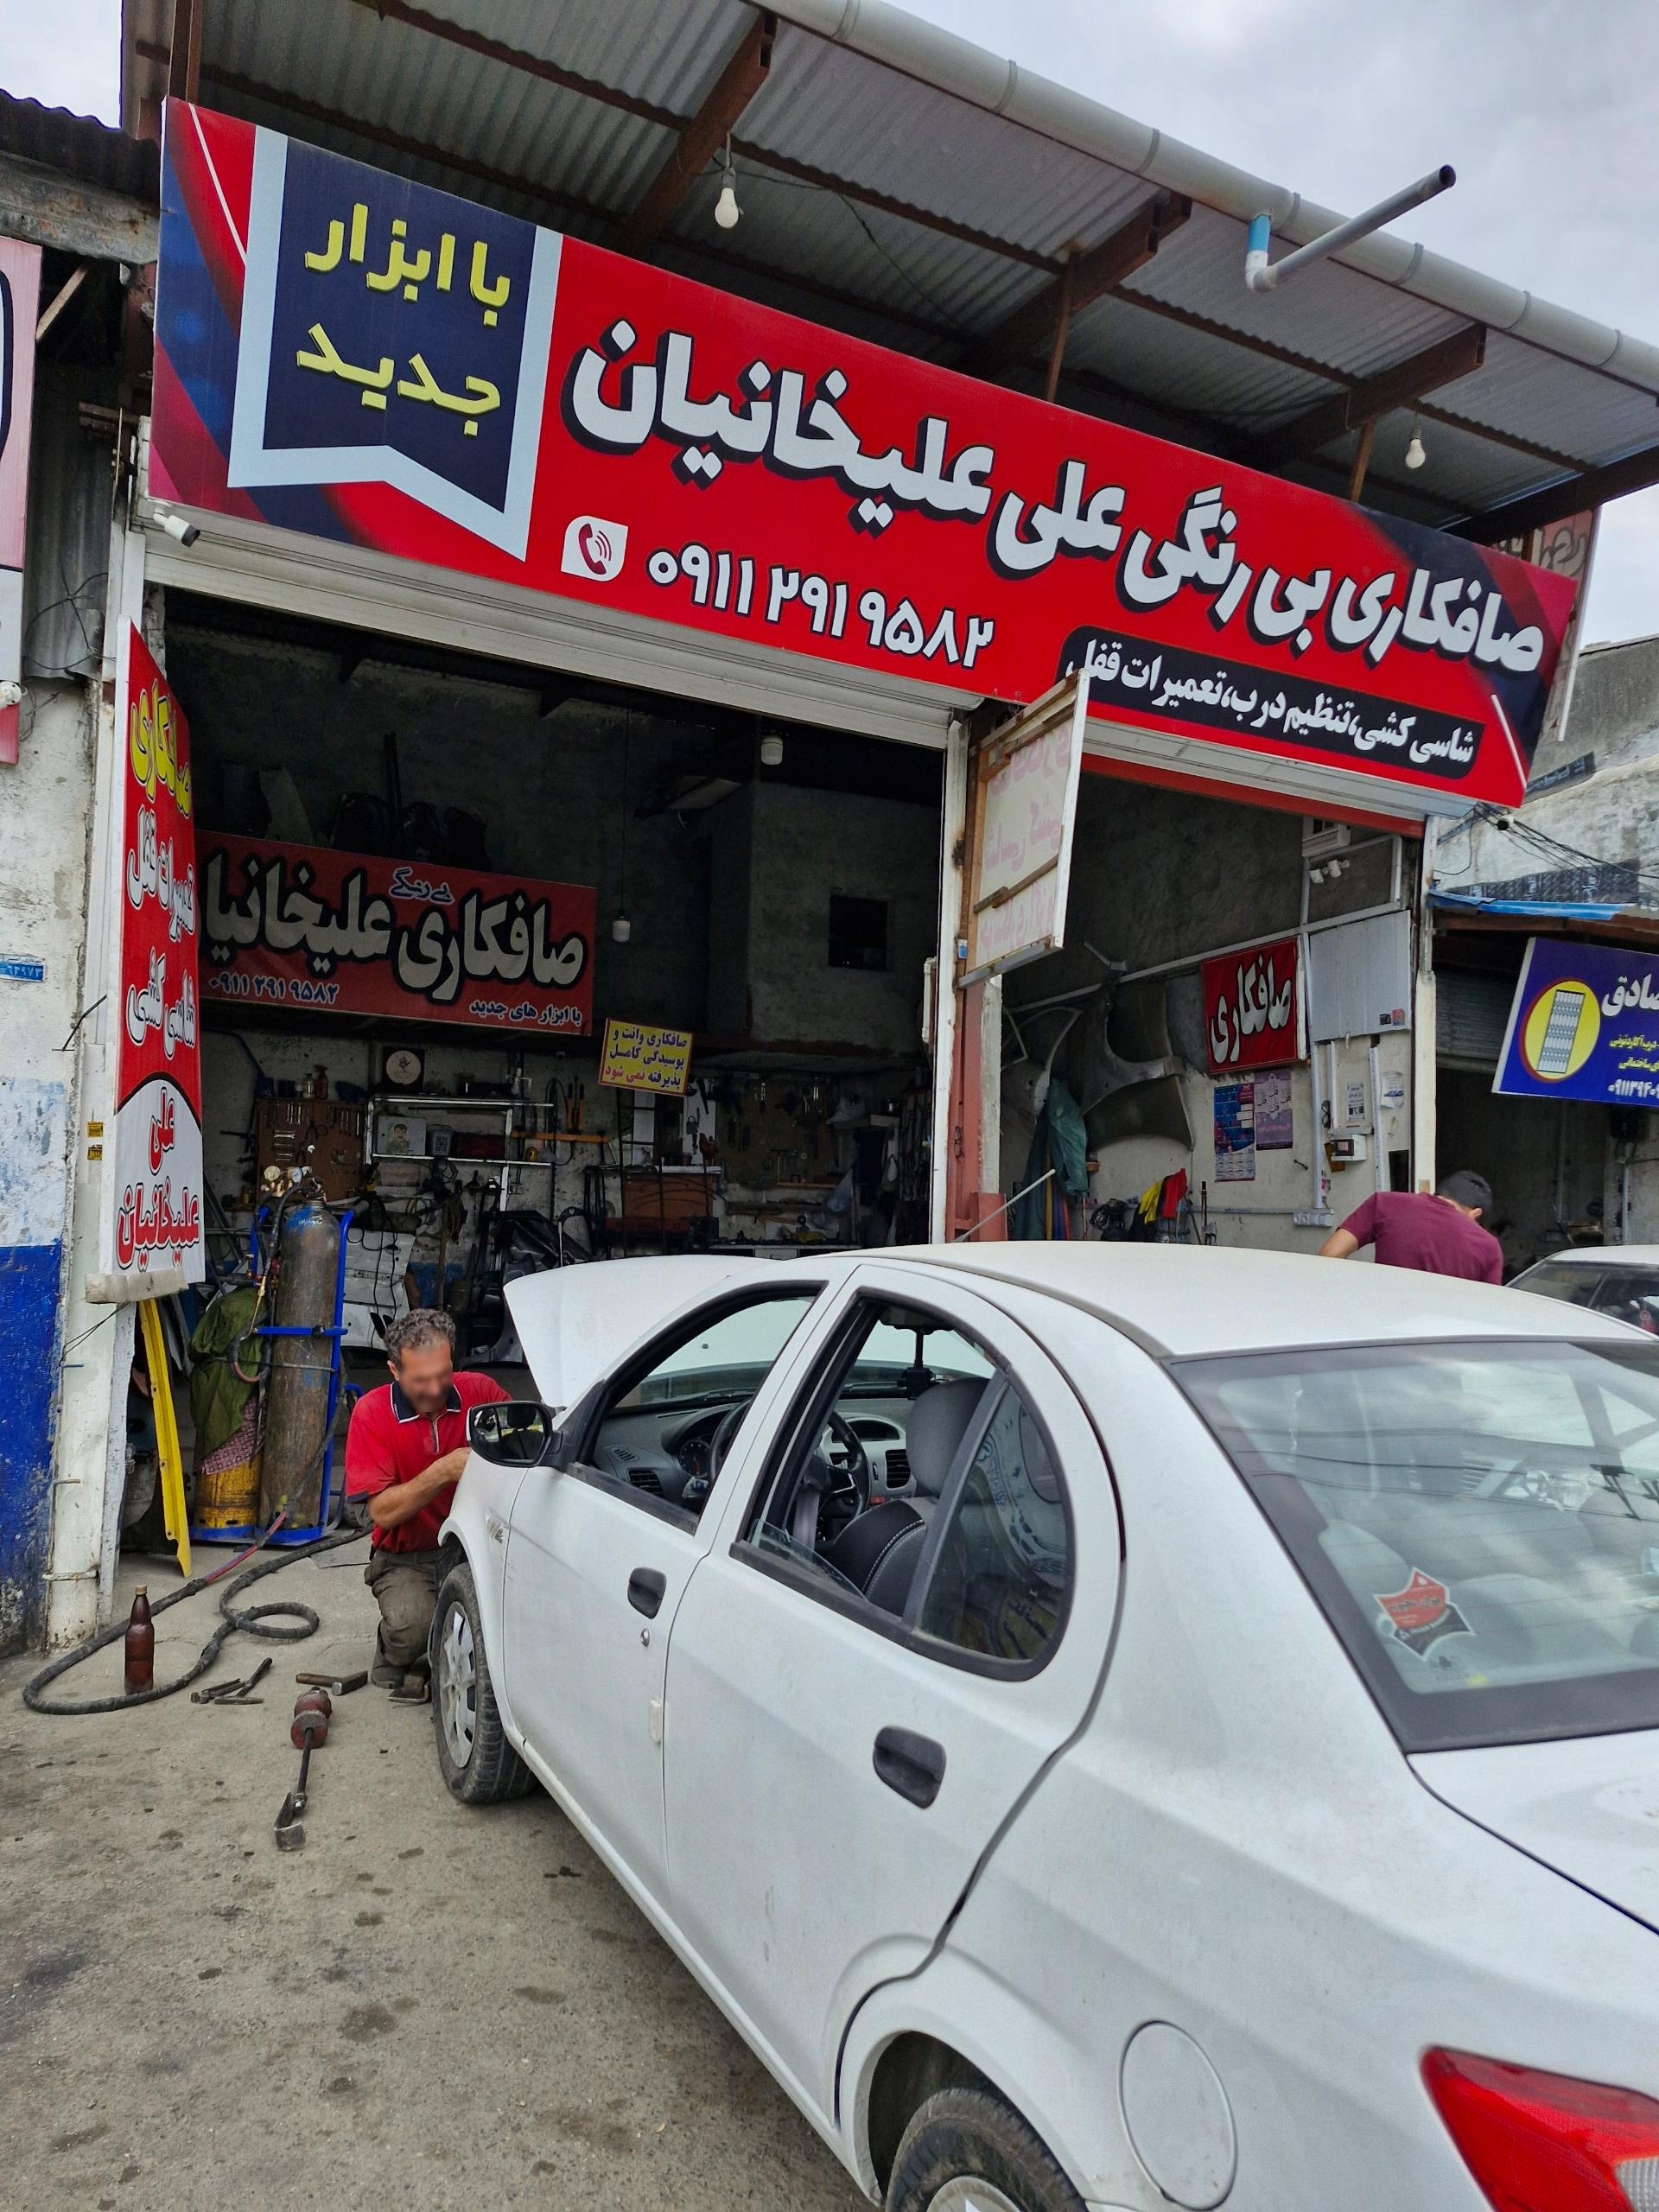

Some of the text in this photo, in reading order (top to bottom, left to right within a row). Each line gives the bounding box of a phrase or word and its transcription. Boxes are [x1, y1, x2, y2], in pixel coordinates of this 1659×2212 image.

[304, 203, 512, 327] با ابزار
[296, 322, 501, 436] جدید
[564, 319, 1544, 673] صافکاری بی رنگی علی علیخانیان
[130, 677, 191, 819] صافکاری
[1408, 727, 1475, 763] شاسی
[126, 804, 157, 910] قفل
[431, 882, 455, 905] بی
[204, 852, 584, 1001] صافکاری علیخانیا
[126, 946, 196, 1059] شاسی کشی
[469, 999, 508, 1020] جدید
[570, 1007, 582, 1027] با
[613, 1027, 688, 1047] صافکاری وانت و
[1211, 953, 1292, 1064] صافکاری
[605, 1065, 681, 1090] پذیرفته نمی شود
[643, 1050, 684, 1071] پوسیدگی
[149, 1086, 175, 1175] علی
[116, 1175, 201, 1272] علیخانیان
